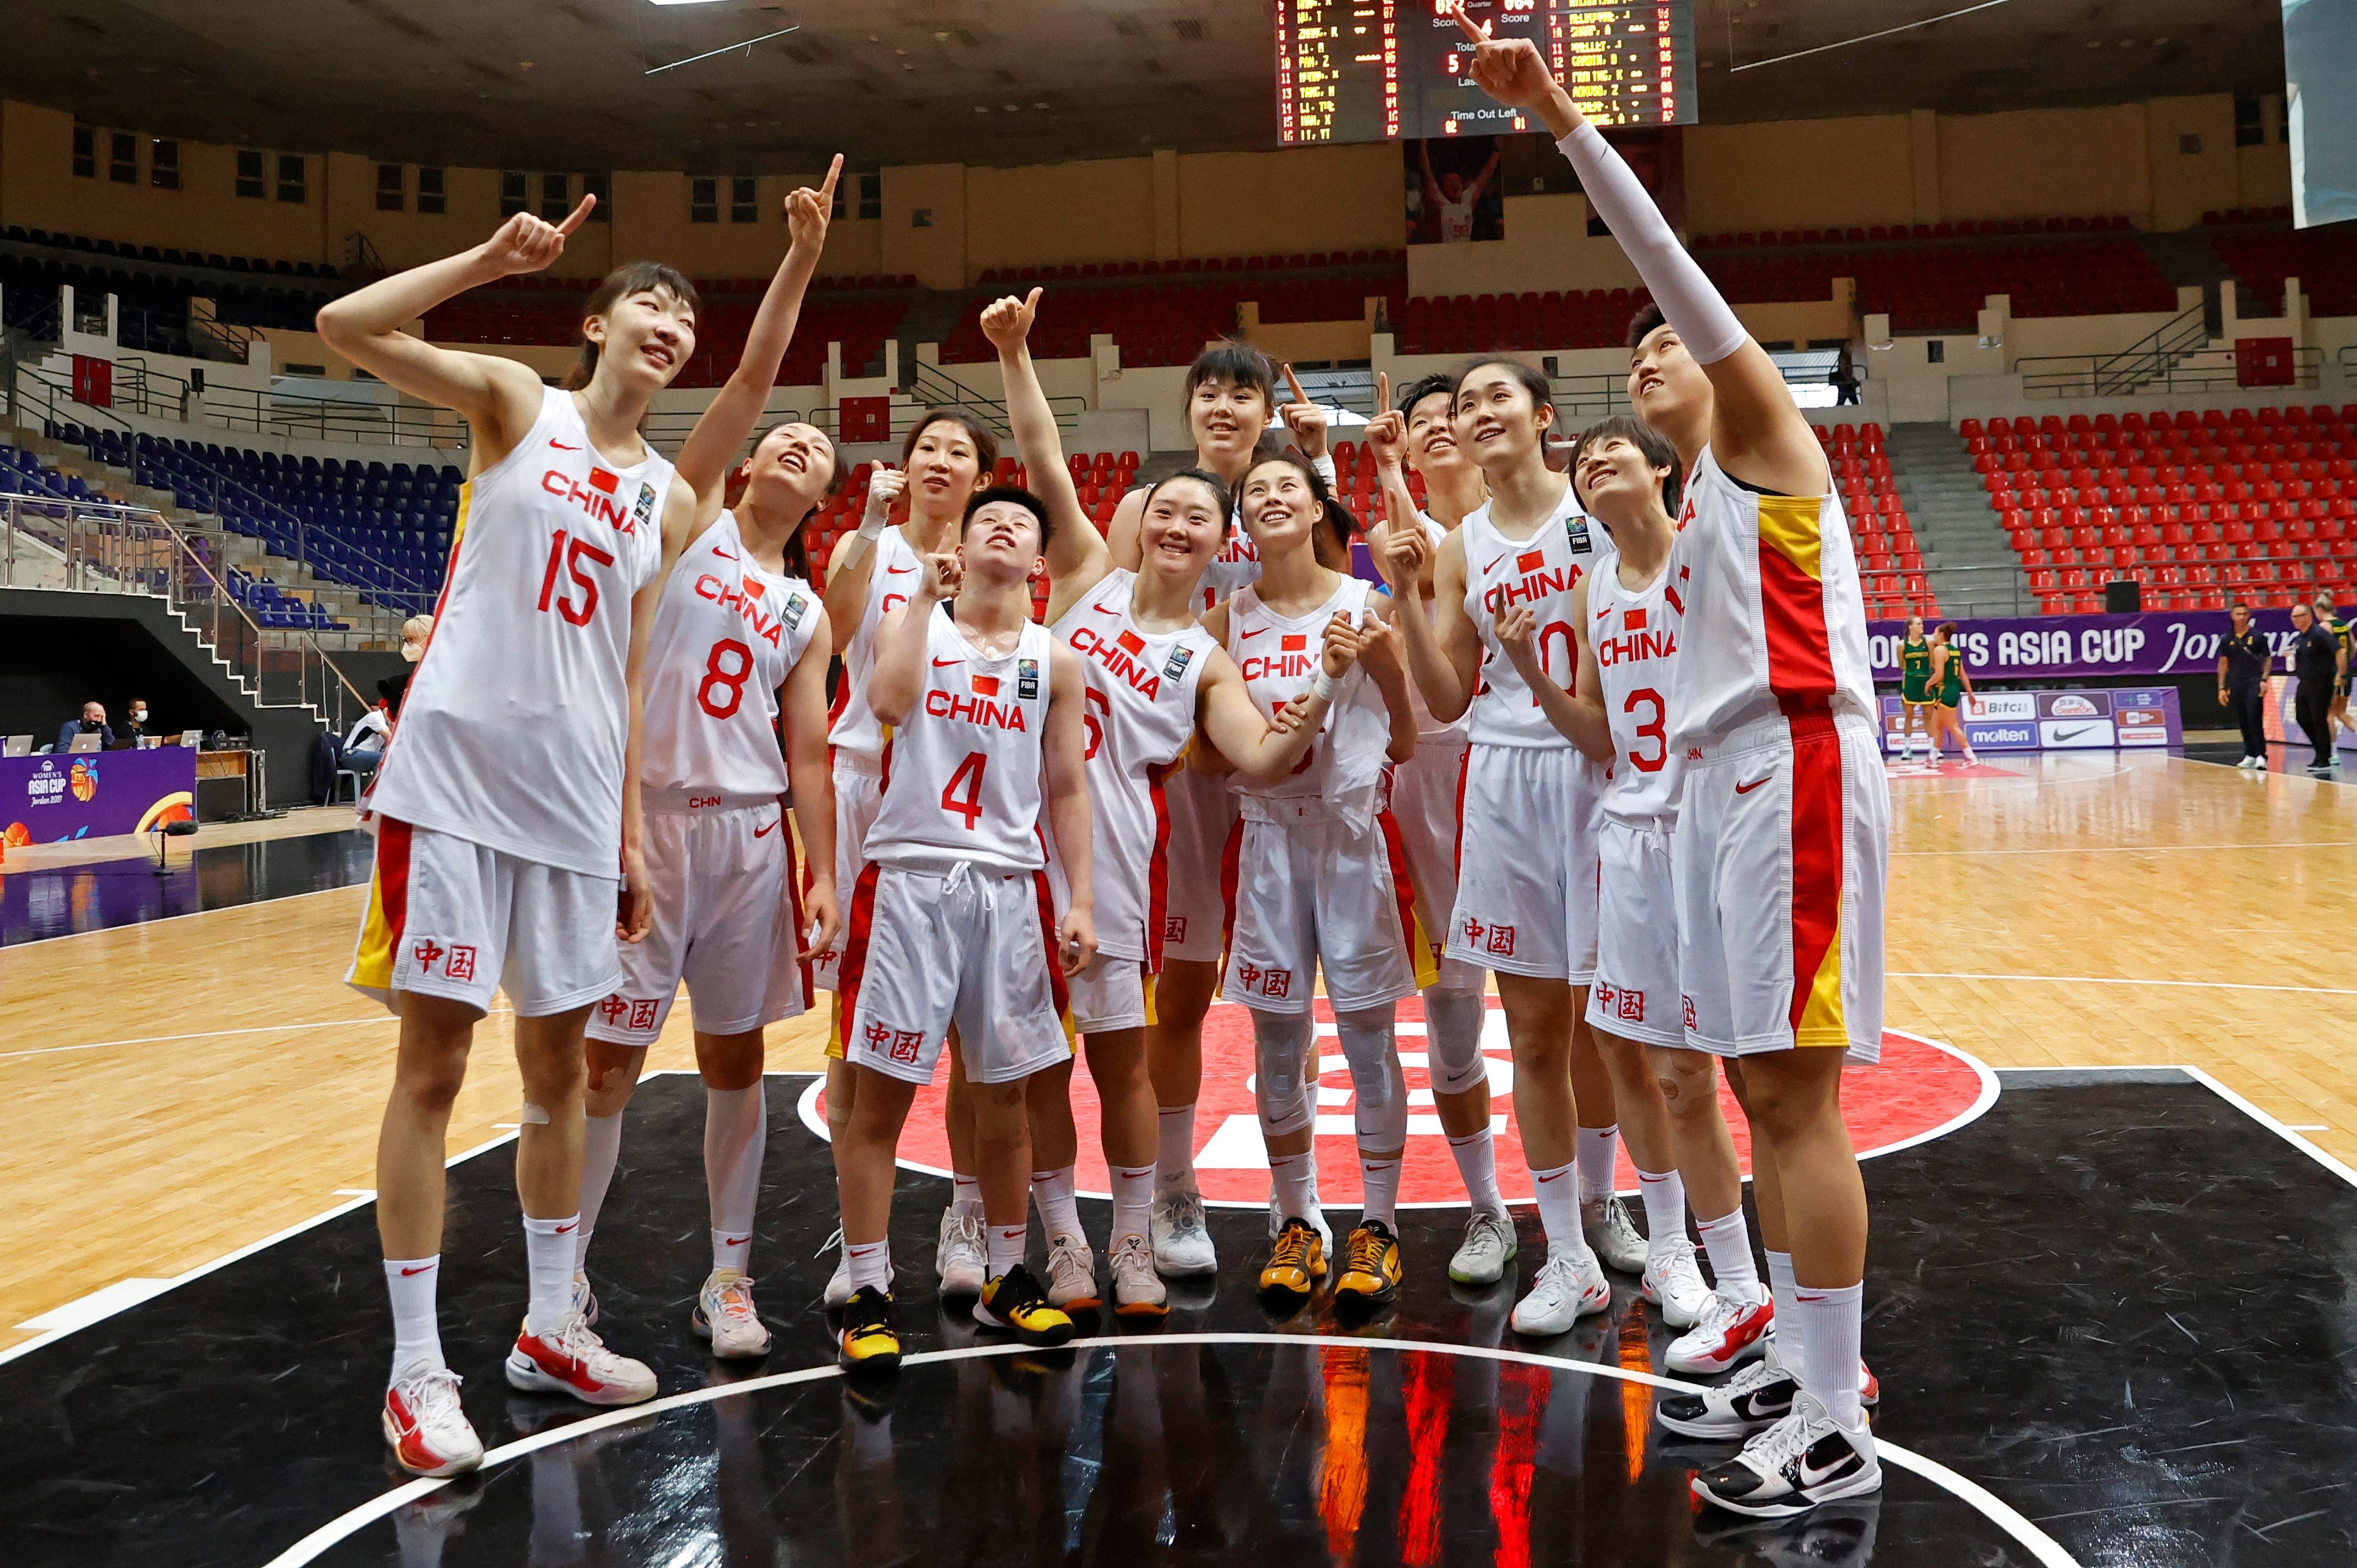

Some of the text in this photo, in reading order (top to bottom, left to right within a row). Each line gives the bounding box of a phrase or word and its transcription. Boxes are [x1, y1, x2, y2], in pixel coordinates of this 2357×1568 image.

[1501, 13, 1530, 23] Score
[1448, 54, 1459, 73] 5
[1455, 42, 1477, 52] Tota
[1458, 77, 1479, 86] Las
[1451, 108, 1517, 121] Time Out Left
[541, 470, 636, 544] CHINA
[538, 528, 614, 628] 15
[695, 573, 783, 649] CHINA
[1070, 627, 1161, 702] CHINA
[1600, 629, 1676, 668] CHINA
[1999, 631, 2072, 665] ASIA
[2081, 628, 2146, 663] CUP
[698, 637, 754, 719] 8
[1021, 681, 1035, 690] FIBA
[1242, 654, 1321, 682] CHIN
[925, 689, 1026, 733] CHINA
[1623, 688, 1667, 773] 3
[1972, 729, 2029, 743] molten
[29, 778, 66, 795] ASIA CUP
[32, 771, 62, 779] WOMEN'S
[941, 751, 987, 831] 4
[689, 796, 721, 808] CHN
[1464, 917, 1515, 956] 中国
[415, 939, 477, 982] 中国
[1239, 962, 1292, 998] 中国
[600, 993, 660, 1029] 中国
[1596, 981, 1645, 1022] 中国
[865, 1022, 924, 1064] 中国
